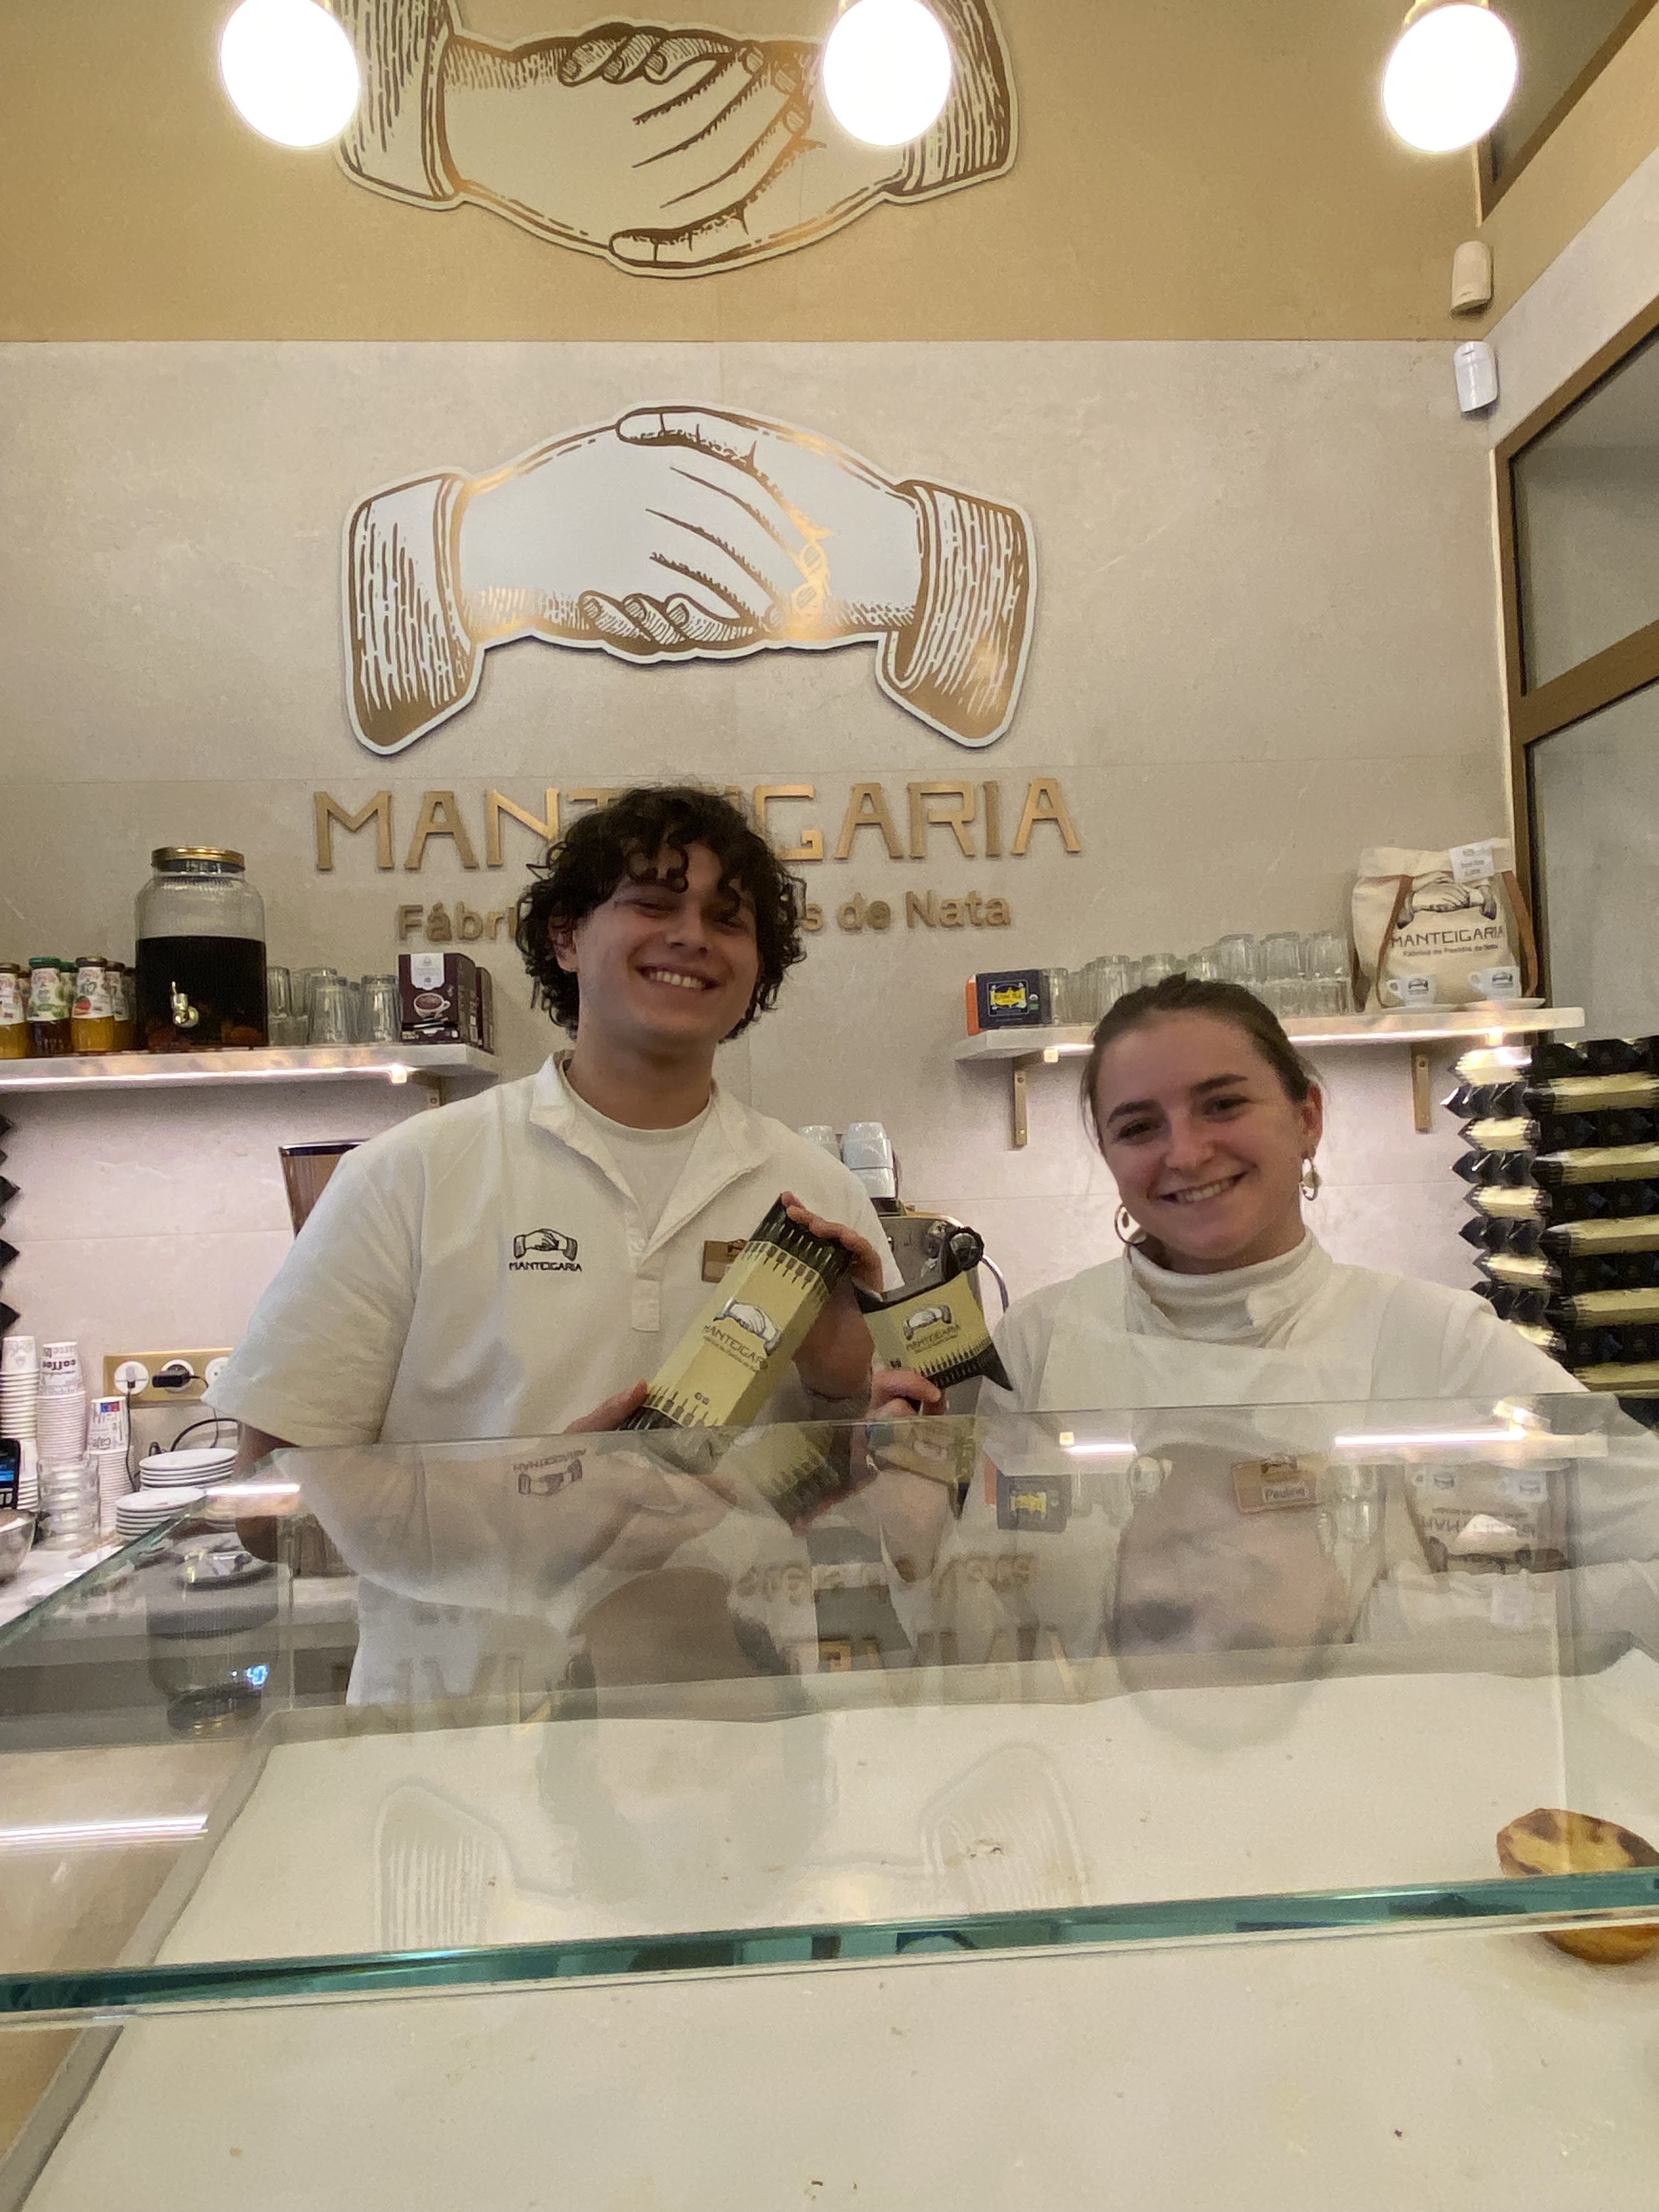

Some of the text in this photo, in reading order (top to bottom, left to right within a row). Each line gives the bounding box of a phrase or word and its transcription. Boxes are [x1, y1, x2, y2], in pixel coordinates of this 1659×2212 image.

[837, 892, 891, 930] de
[905, 889, 1011, 928] Nata
[509, 1262, 582, 1272] MANTEIGARIA
